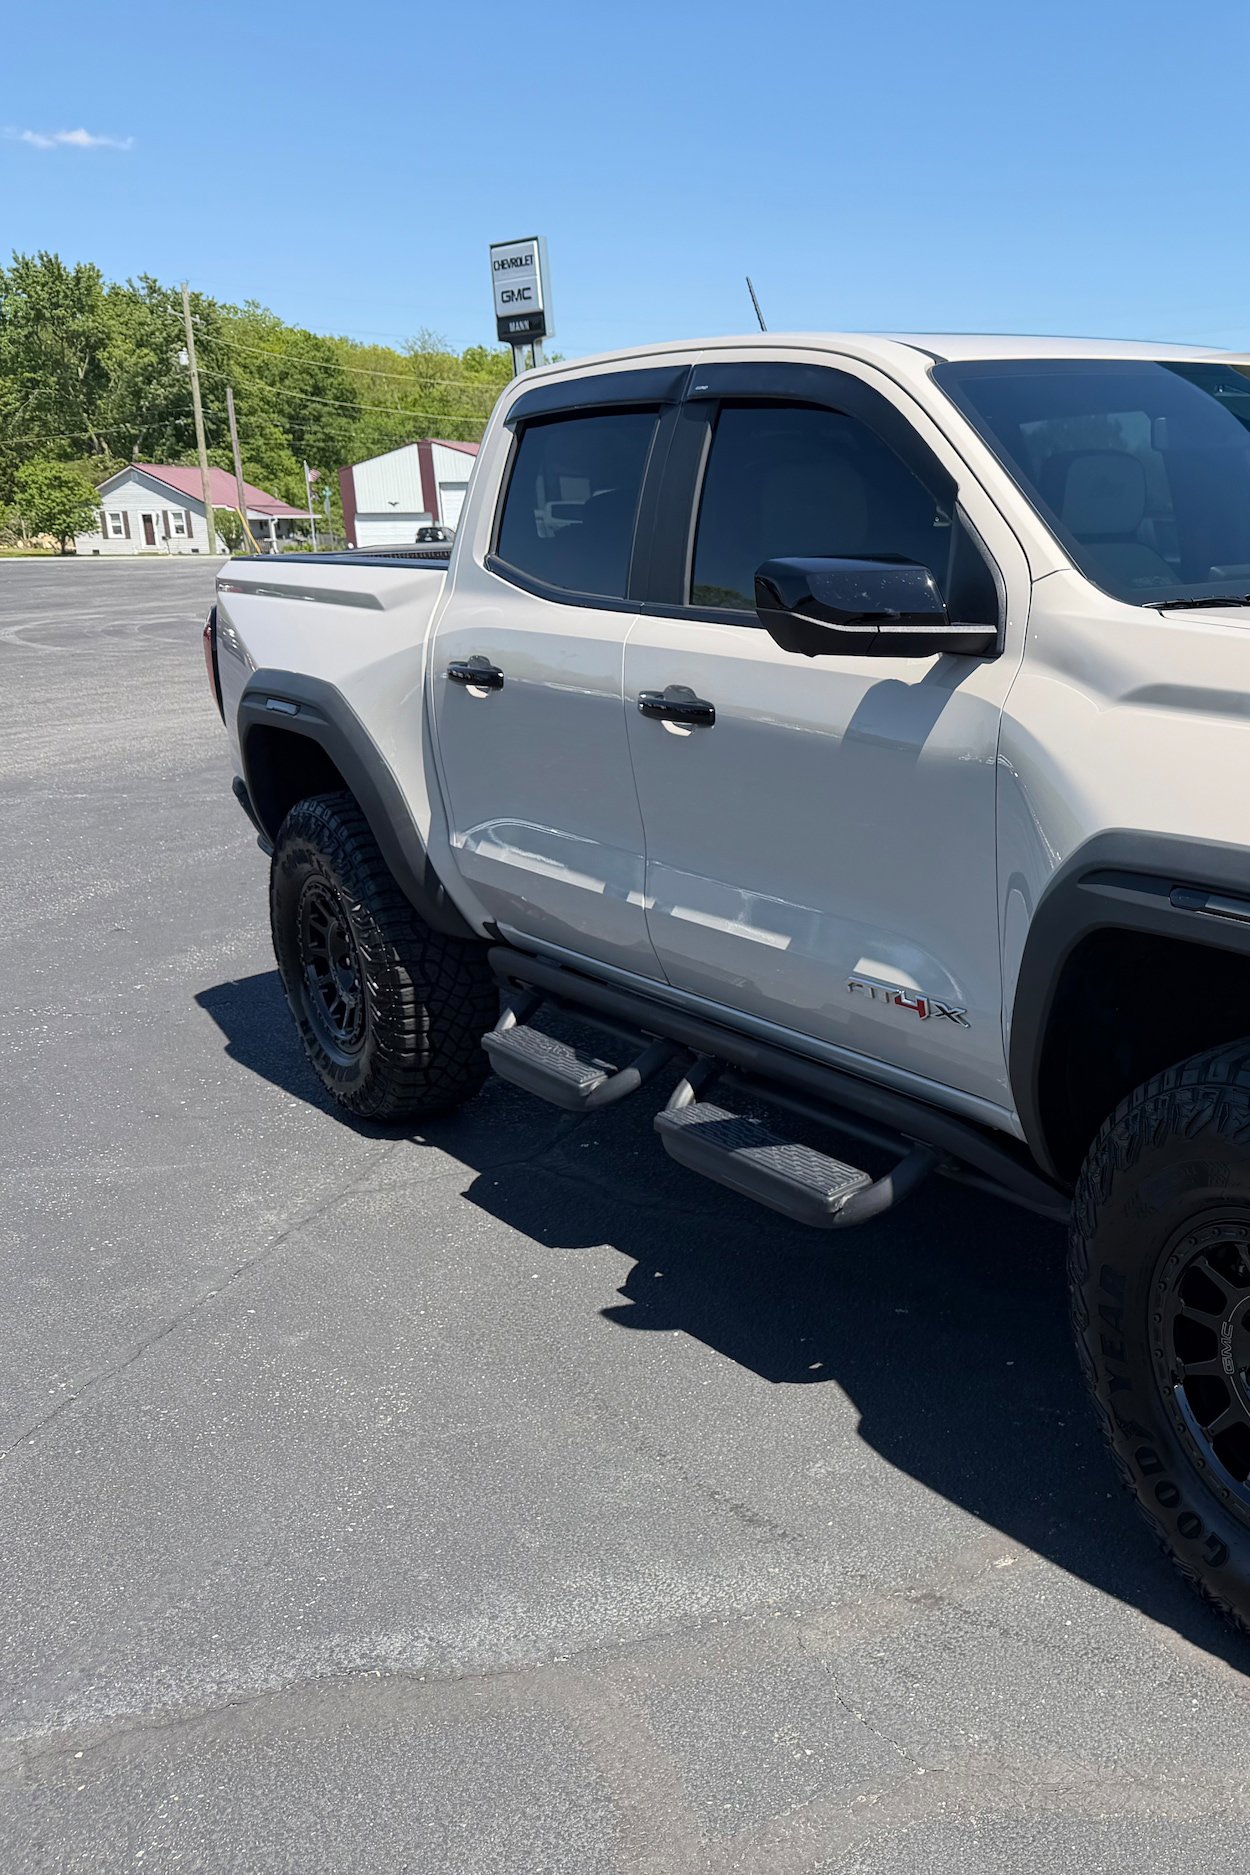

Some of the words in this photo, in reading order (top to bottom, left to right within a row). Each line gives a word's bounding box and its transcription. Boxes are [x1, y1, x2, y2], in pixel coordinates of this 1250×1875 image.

[493, 254, 533, 271] CHEVROLET
[501, 286, 532, 303] GMC
[509, 319, 530, 333] MANN
[848, 976, 971, 1028] AT4X
[1220, 1320, 1235, 1375] GMC
